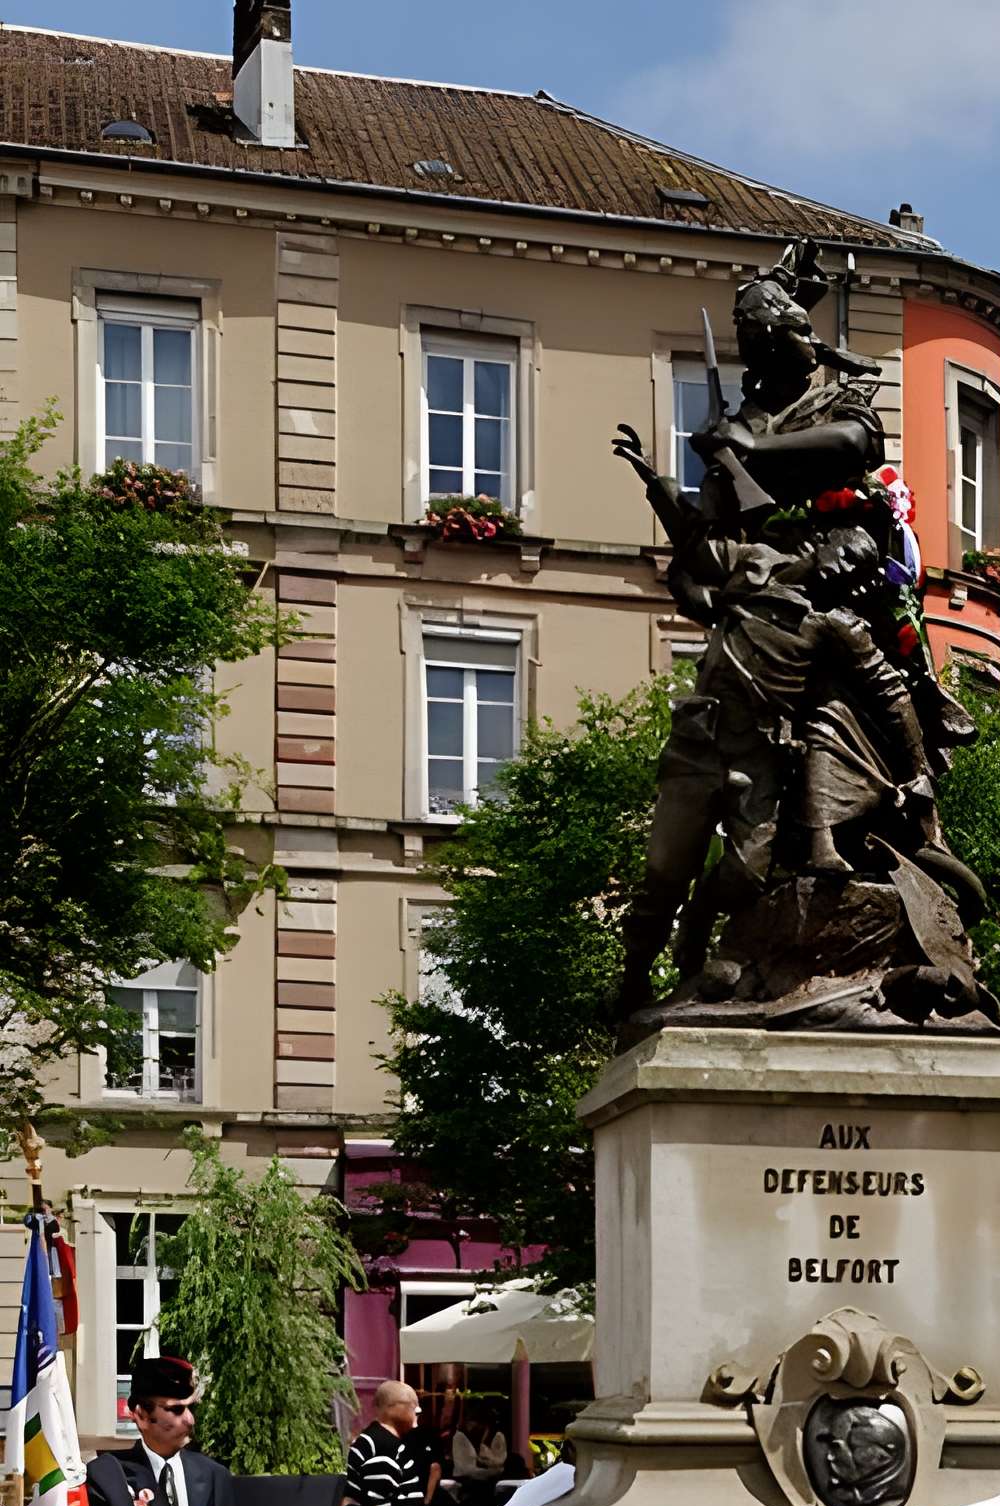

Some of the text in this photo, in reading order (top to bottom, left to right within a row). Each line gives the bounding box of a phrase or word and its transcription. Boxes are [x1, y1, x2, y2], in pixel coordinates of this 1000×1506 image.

[820, 1124, 871, 1149] AUX
[764, 1168, 925, 1196] DEFENSEURS
[829, 1214, 860, 1239] DE
[788, 1257, 900, 1283] BELFORT
